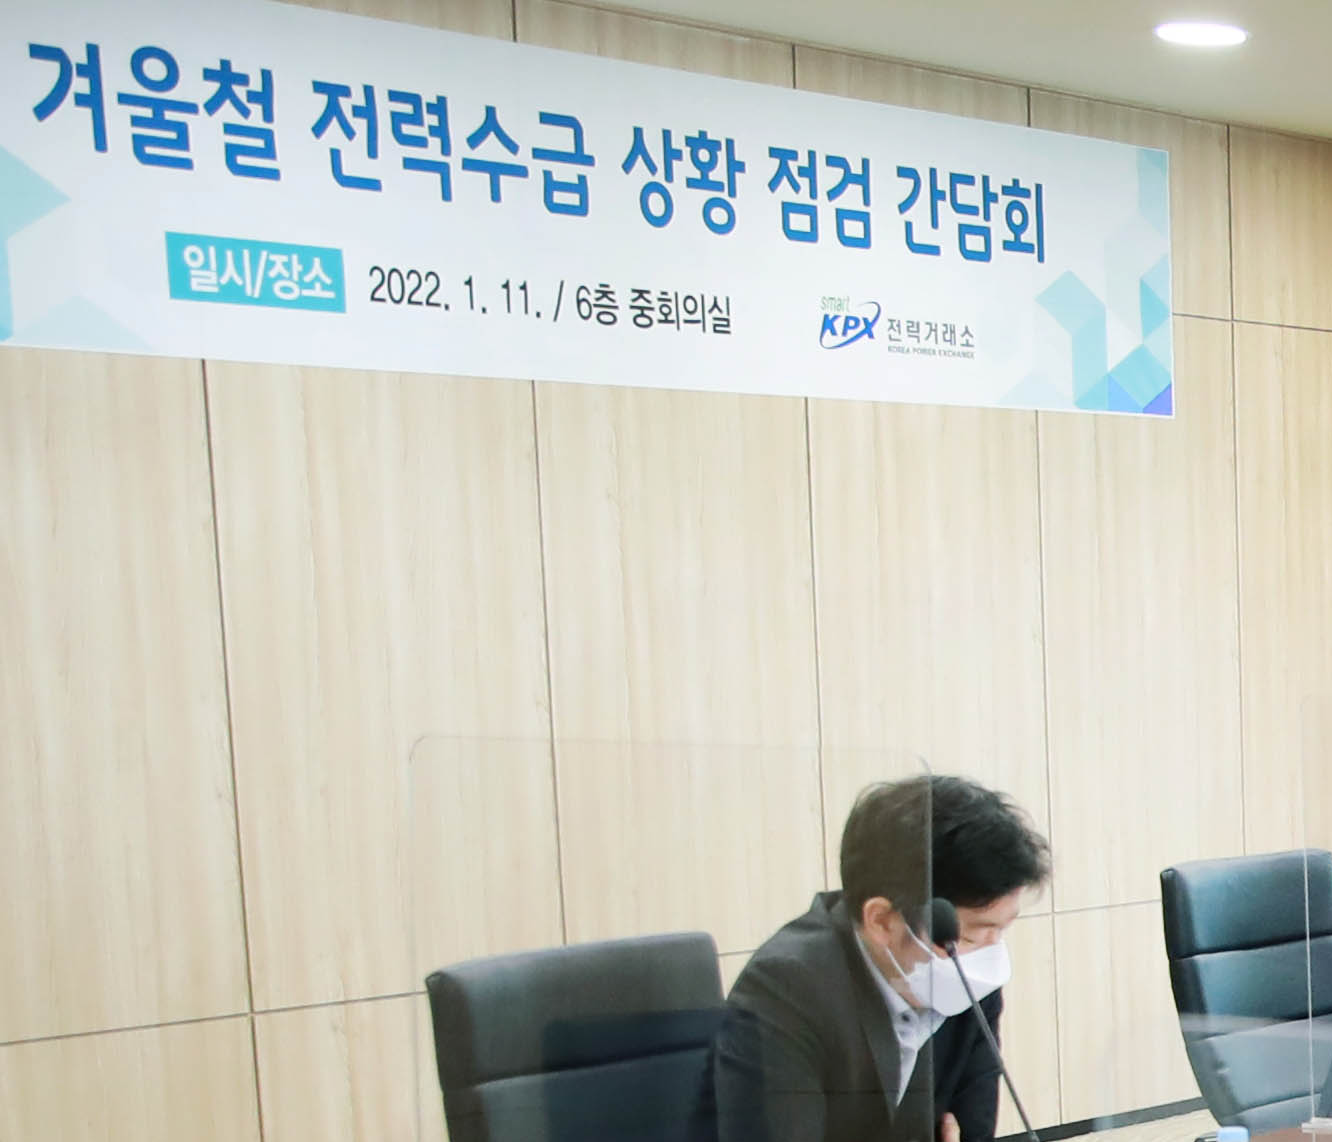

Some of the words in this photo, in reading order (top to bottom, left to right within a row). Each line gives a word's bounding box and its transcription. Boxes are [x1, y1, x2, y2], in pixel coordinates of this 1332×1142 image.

[27, 41, 282, 182] 겨울철
[310, 79, 596, 218] 전력수급
[621, 125, 746, 236] 상황
[766, 146, 872, 250] 점검
[895, 161, 1046, 264] 간담회
[182, 243, 336, 301] 일시/장소
[369, 265, 450, 311] 2022.
[463, 275, 487, 314] 1.
[501, 278, 541, 318] 11.
[576, 283, 620, 327] 6층
[629, 287, 732, 335] 중회의실
[820, 313, 876, 340] KPX
[887, 318, 975, 348] 전력거래소
